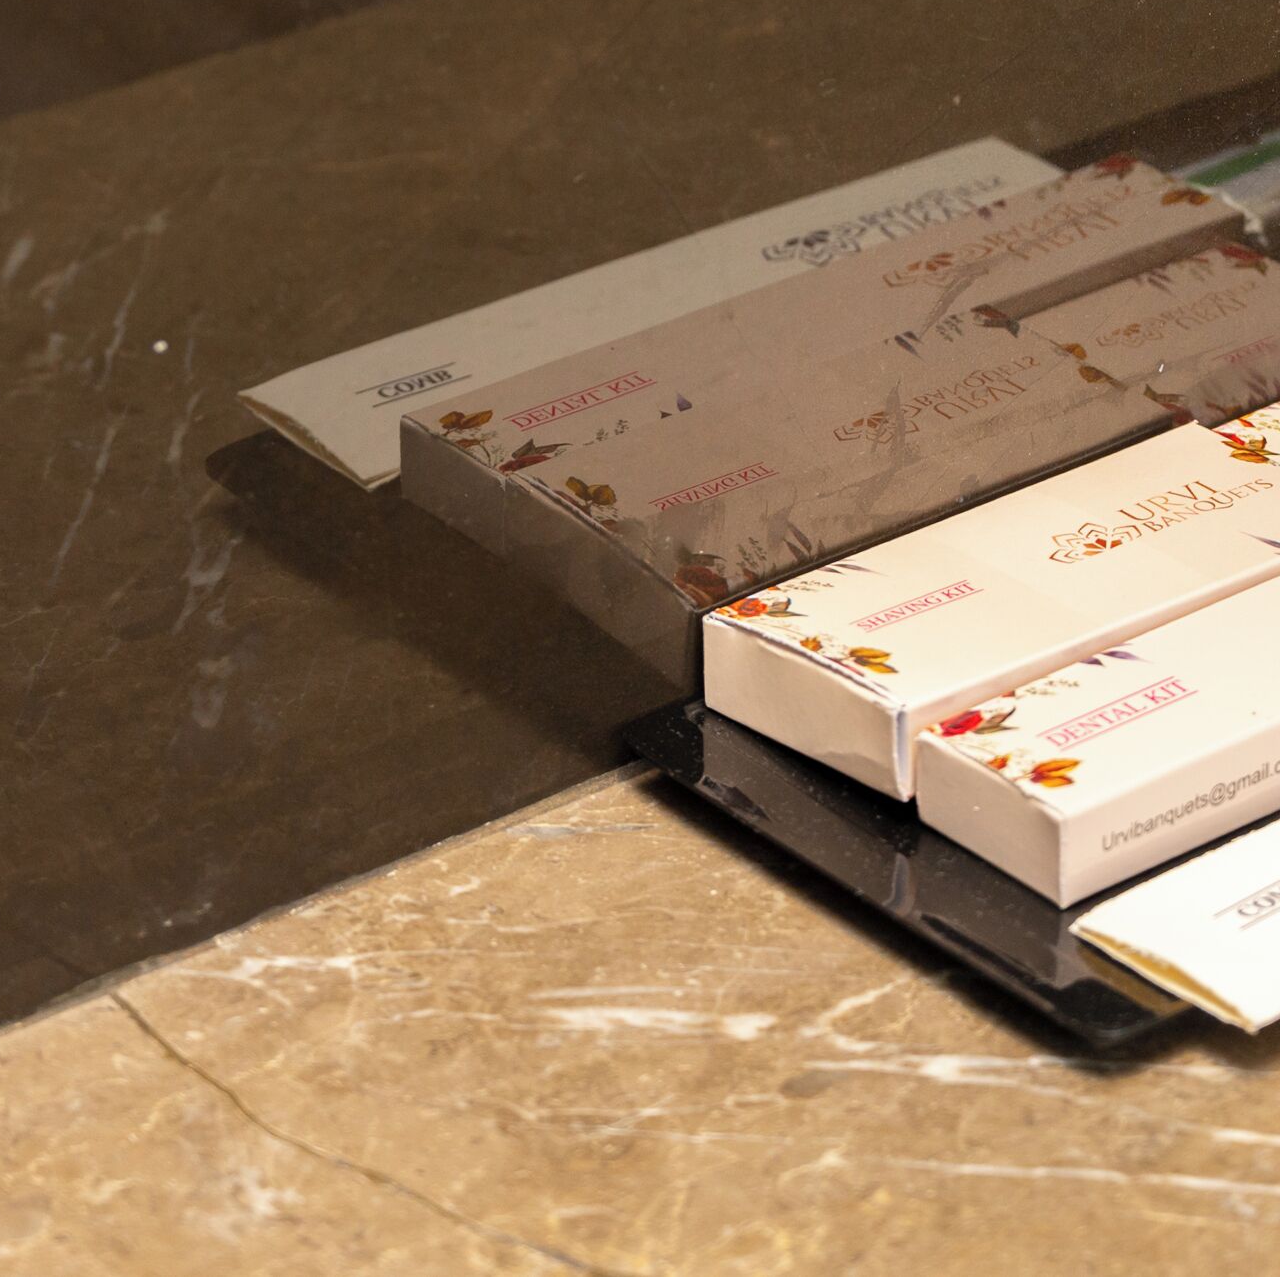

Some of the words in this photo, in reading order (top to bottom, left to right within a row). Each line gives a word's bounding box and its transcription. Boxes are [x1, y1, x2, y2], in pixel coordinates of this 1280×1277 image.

[1117, 480, 1219, 521] URVI
[1143, 477, 1274, 532] BANQUETS
[856, 595, 942, 631] SHAVING
[941, 582, 975, 599] KIT
[1046, 702, 1148, 747] DENTAL
[1143, 679, 1189, 704] KIT
